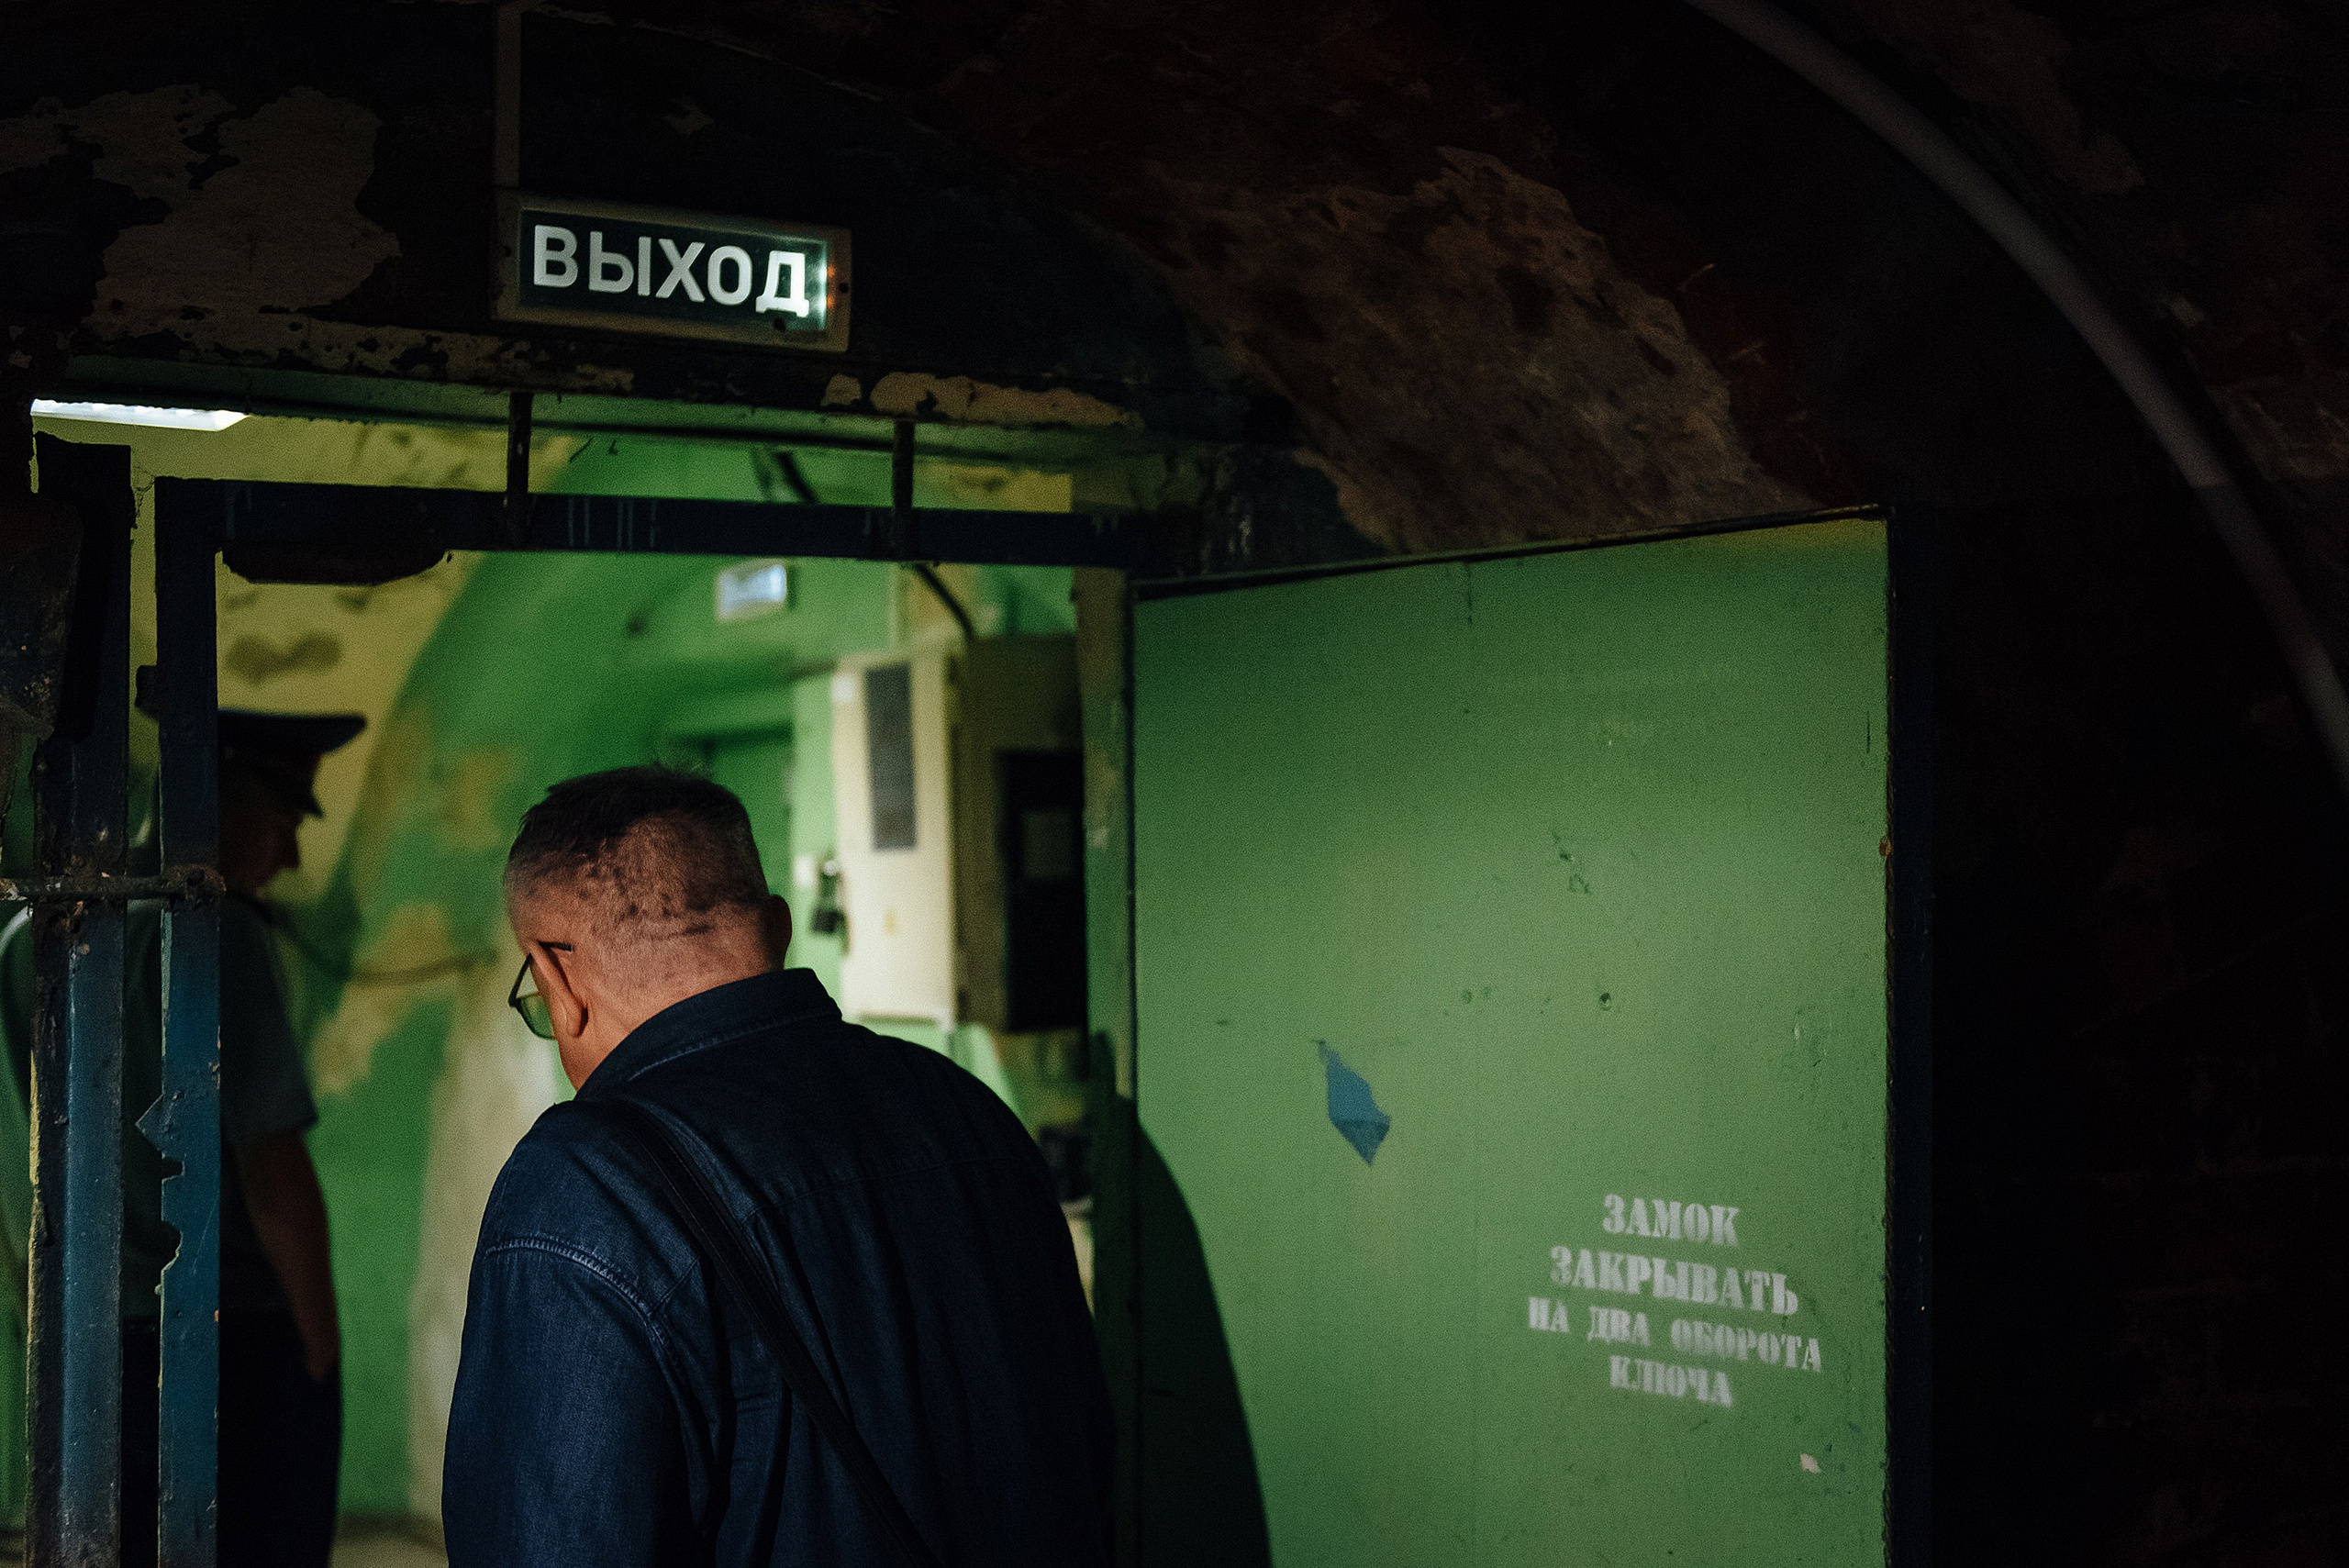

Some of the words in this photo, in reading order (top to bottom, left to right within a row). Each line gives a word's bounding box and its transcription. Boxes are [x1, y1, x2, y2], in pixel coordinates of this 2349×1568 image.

[533, 225, 809, 317] ВЫХОД
[1603, 1194, 1740, 1248] ЗАМОК
[1550, 1245, 1799, 1316] ЗАКРЫВАТЬ
[1528, 1296, 1569, 1333] НА
[1587, 1306, 1651, 1347] ДВА
[1671, 1318, 1822, 1373] ОБОРОТА
[1609, 1355, 1733, 1407] КЛЮЧА
